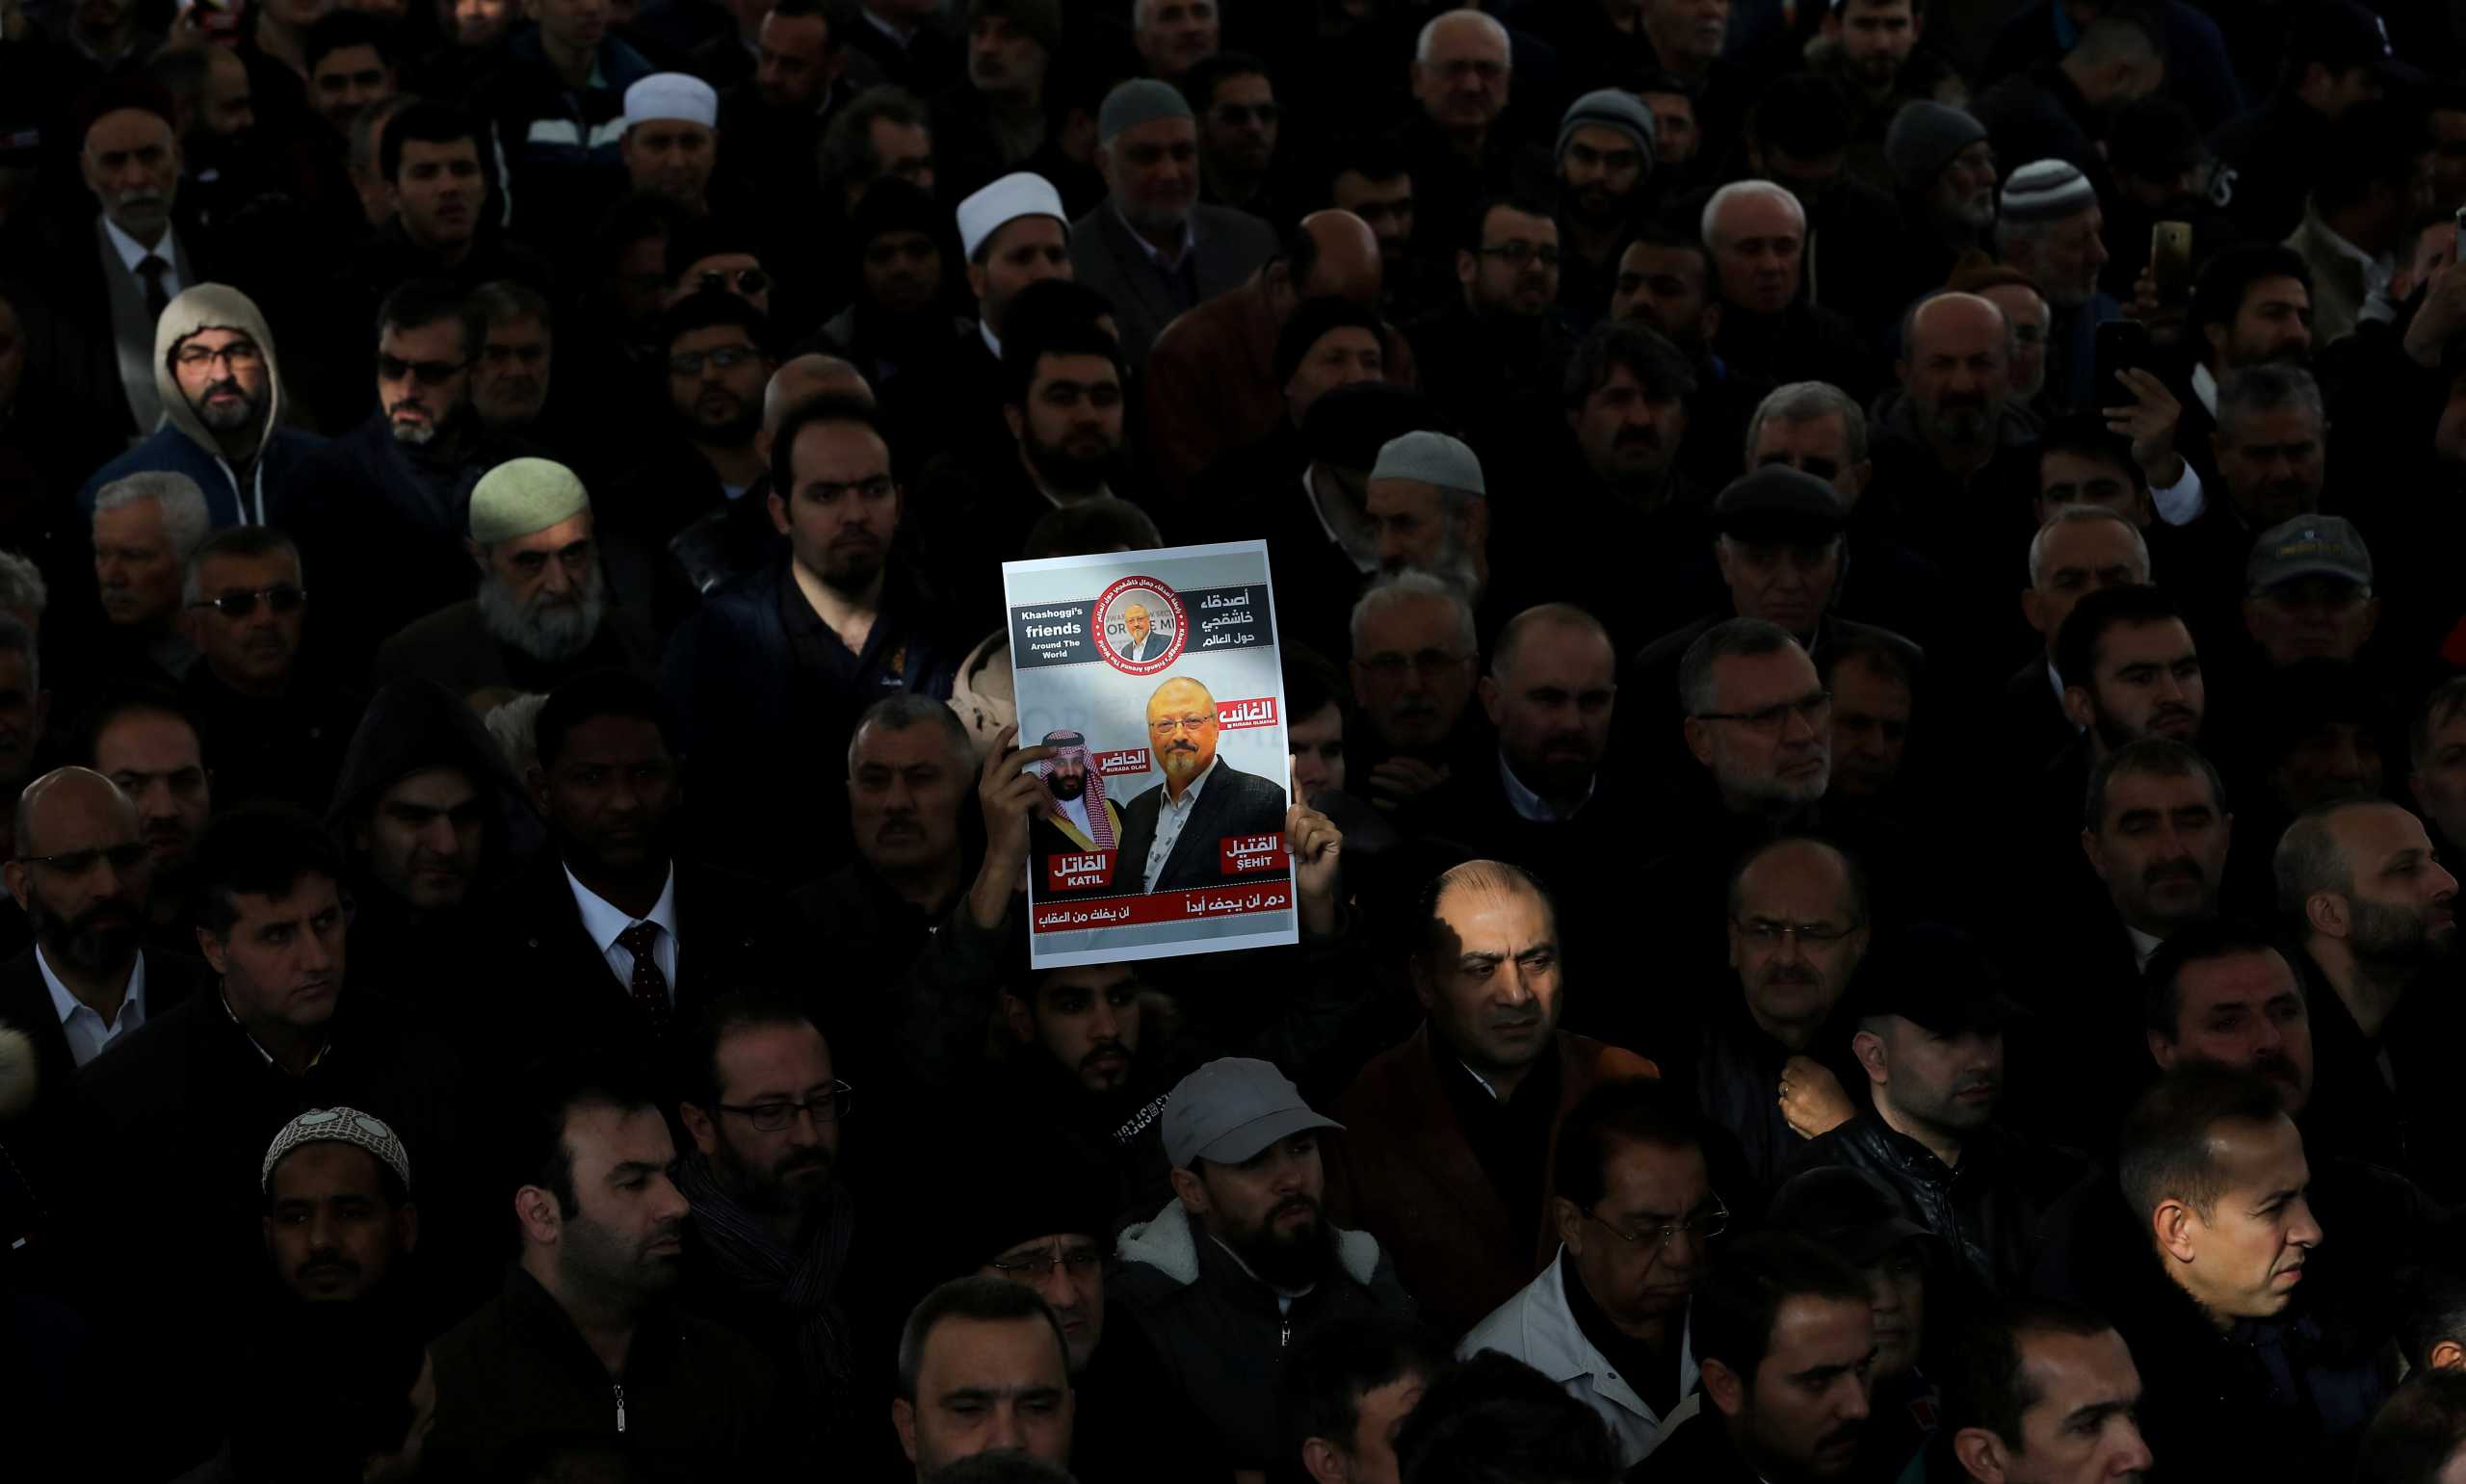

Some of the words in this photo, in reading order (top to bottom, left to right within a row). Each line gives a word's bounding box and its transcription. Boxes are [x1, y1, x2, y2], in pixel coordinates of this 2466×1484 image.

[1200, 587, 1249, 609] أصدقاء
[1021, 607, 1083, 620] Khashoggi's
[1201, 610, 1253, 632] خاشقجي
[1026, 622, 1081, 638] friends
[1031, 640, 1062, 650] Around
[1203, 634, 1231, 647] العالم
[1234, 633, 1255, 644] حول
[1042, 650, 1067, 659] World
[1120, 664, 1143, 672] Around
[1143, 660, 1166, 672] Friends
[1220, 701, 1272, 728] الغائب
[1100, 749, 1145, 770] الحاضر
[1226, 836, 1277, 858] القتيل
[1054, 854, 1106, 876] القاتل
[1237, 854, 1272, 871] ŞEHİT
[1067, 874, 1104, 886] KATIL
[1208, 898, 1243, 913] يجف
[1246, 893, 1260, 908] لن
[1264, 895, 1285, 907] دم
[1038, 911, 1070, 927] العقاب
[1072, 911, 1089, 923] من
[1118, 905, 1130, 919] لن
